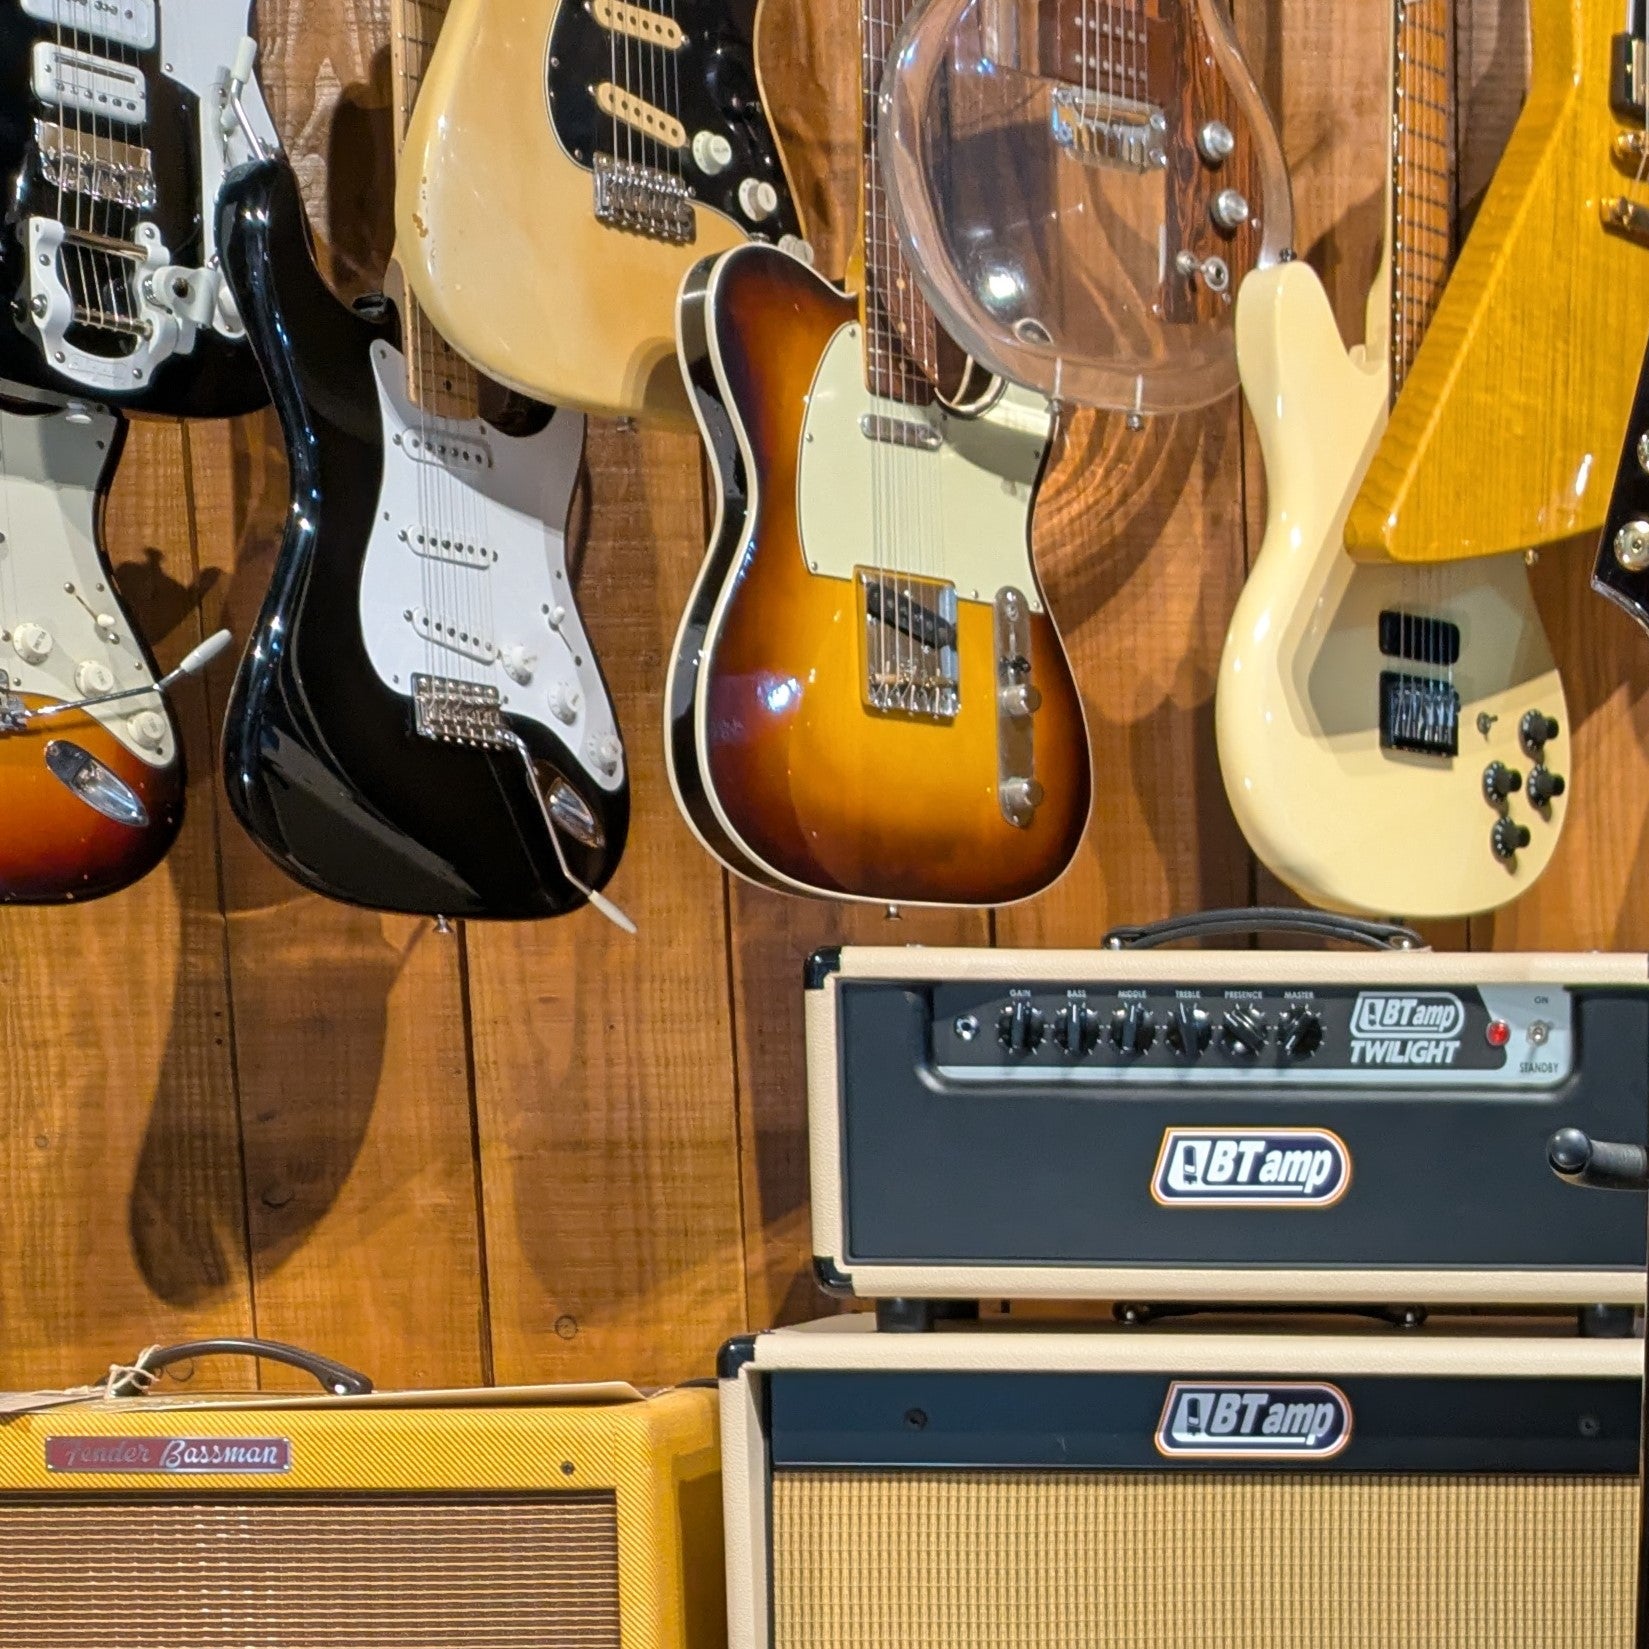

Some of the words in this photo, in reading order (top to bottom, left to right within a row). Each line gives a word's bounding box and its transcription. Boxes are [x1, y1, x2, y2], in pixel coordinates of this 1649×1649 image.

[1009, 989, 1031, 997] GAIN
[1067, 989, 1087, 998] BASS
[1117, 990, 1147, 998] MIDDLE
[1175, 990, 1201, 998] TREBLE
[1224, 990, 1263, 999] PRESENCE
[1284, 991, 1314, 999] MASTER
[1412, 1004, 1456, 1033] amp
[1350, 1040, 1461, 1064] TWILIGHT
[1519, 1062, 1559, 1074] STANDBY
[1206, 1140, 1266, 1183] BT
[1258, 1149, 1333, 1194] amp
[1210, 1393, 1269, 1433] BT
[1262, 1401, 1335, 1446] amp
[65, 1440, 150, 1466] Fender
[159, 1439, 278, 1468] Bassman
